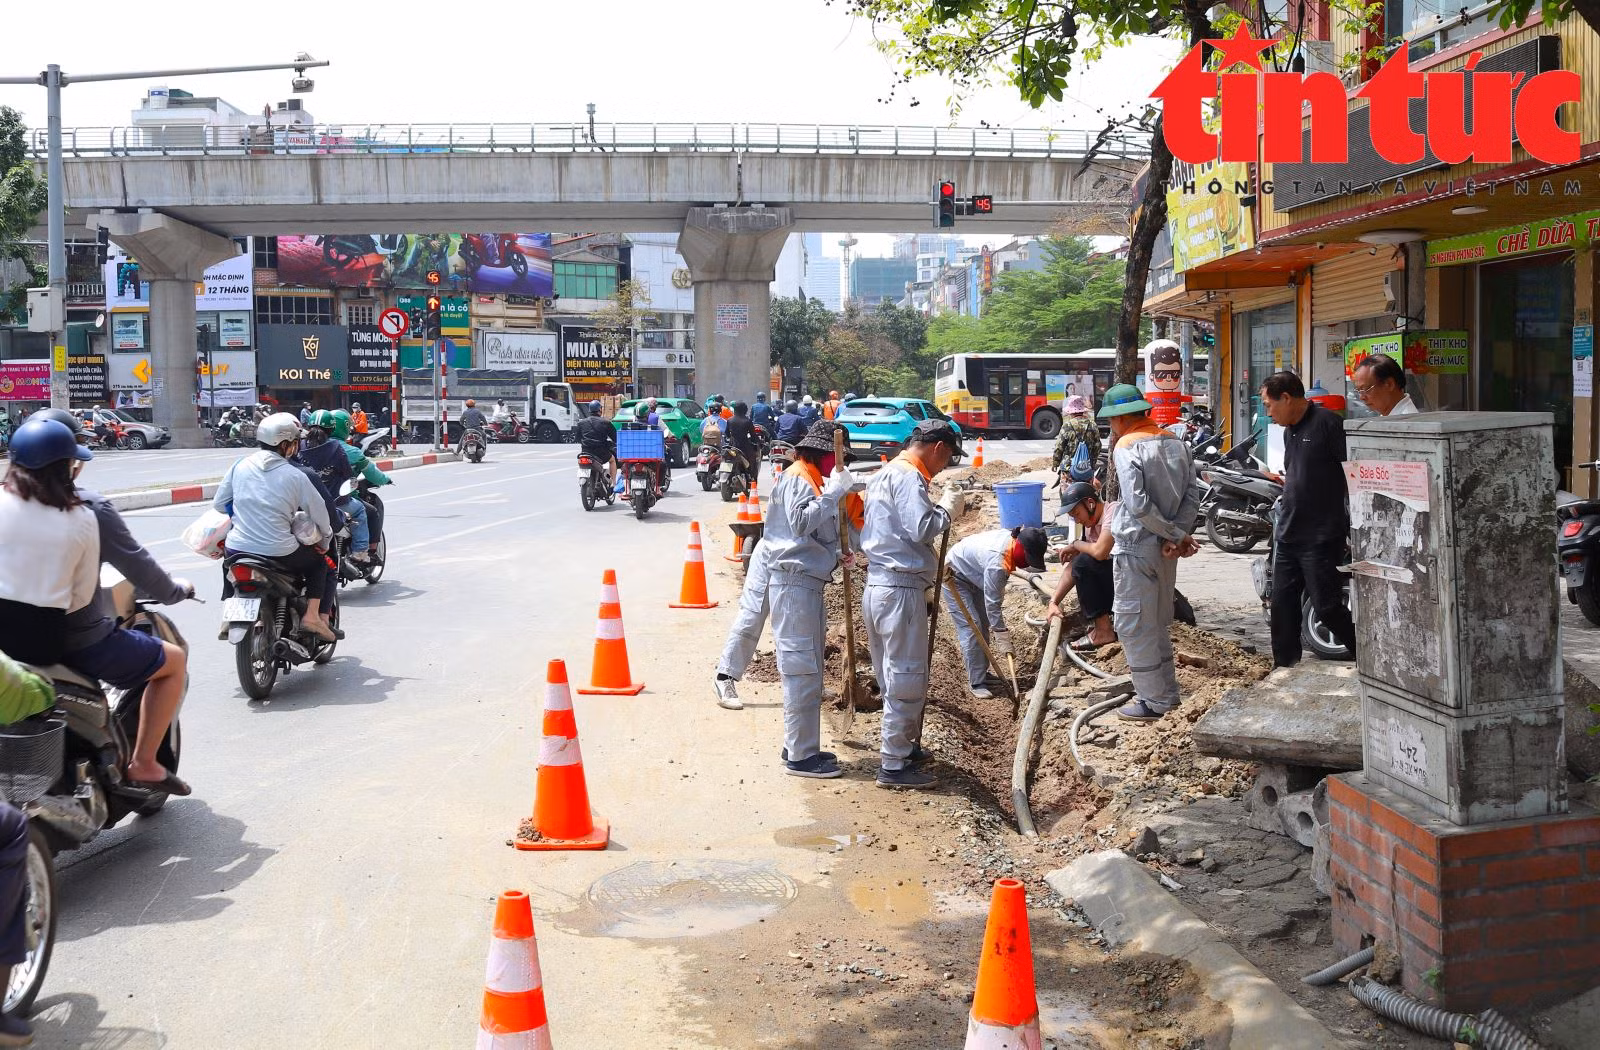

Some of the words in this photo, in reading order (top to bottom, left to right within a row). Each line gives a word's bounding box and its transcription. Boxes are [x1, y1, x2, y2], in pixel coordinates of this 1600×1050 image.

[976, 198, 990, 210] 45
[1498, 225, 1530, 254] CHÈ
[1537, 217, 1577, 248] DỪA
[208, 286, 217, 294] 12
[219, 284, 249, 294] THÁNG
[457, 303, 468, 312] có
[351, 330, 371, 343] TÙNG
[1385, 342, 1399, 352] KHO
[1448, 338, 1467, 349] KHO
[566, 342, 598, 358] MUA
[280, 369, 302, 379] KOI
[307, 369, 330, 379] Thé
[1360, 466, 1374, 479] Sale
